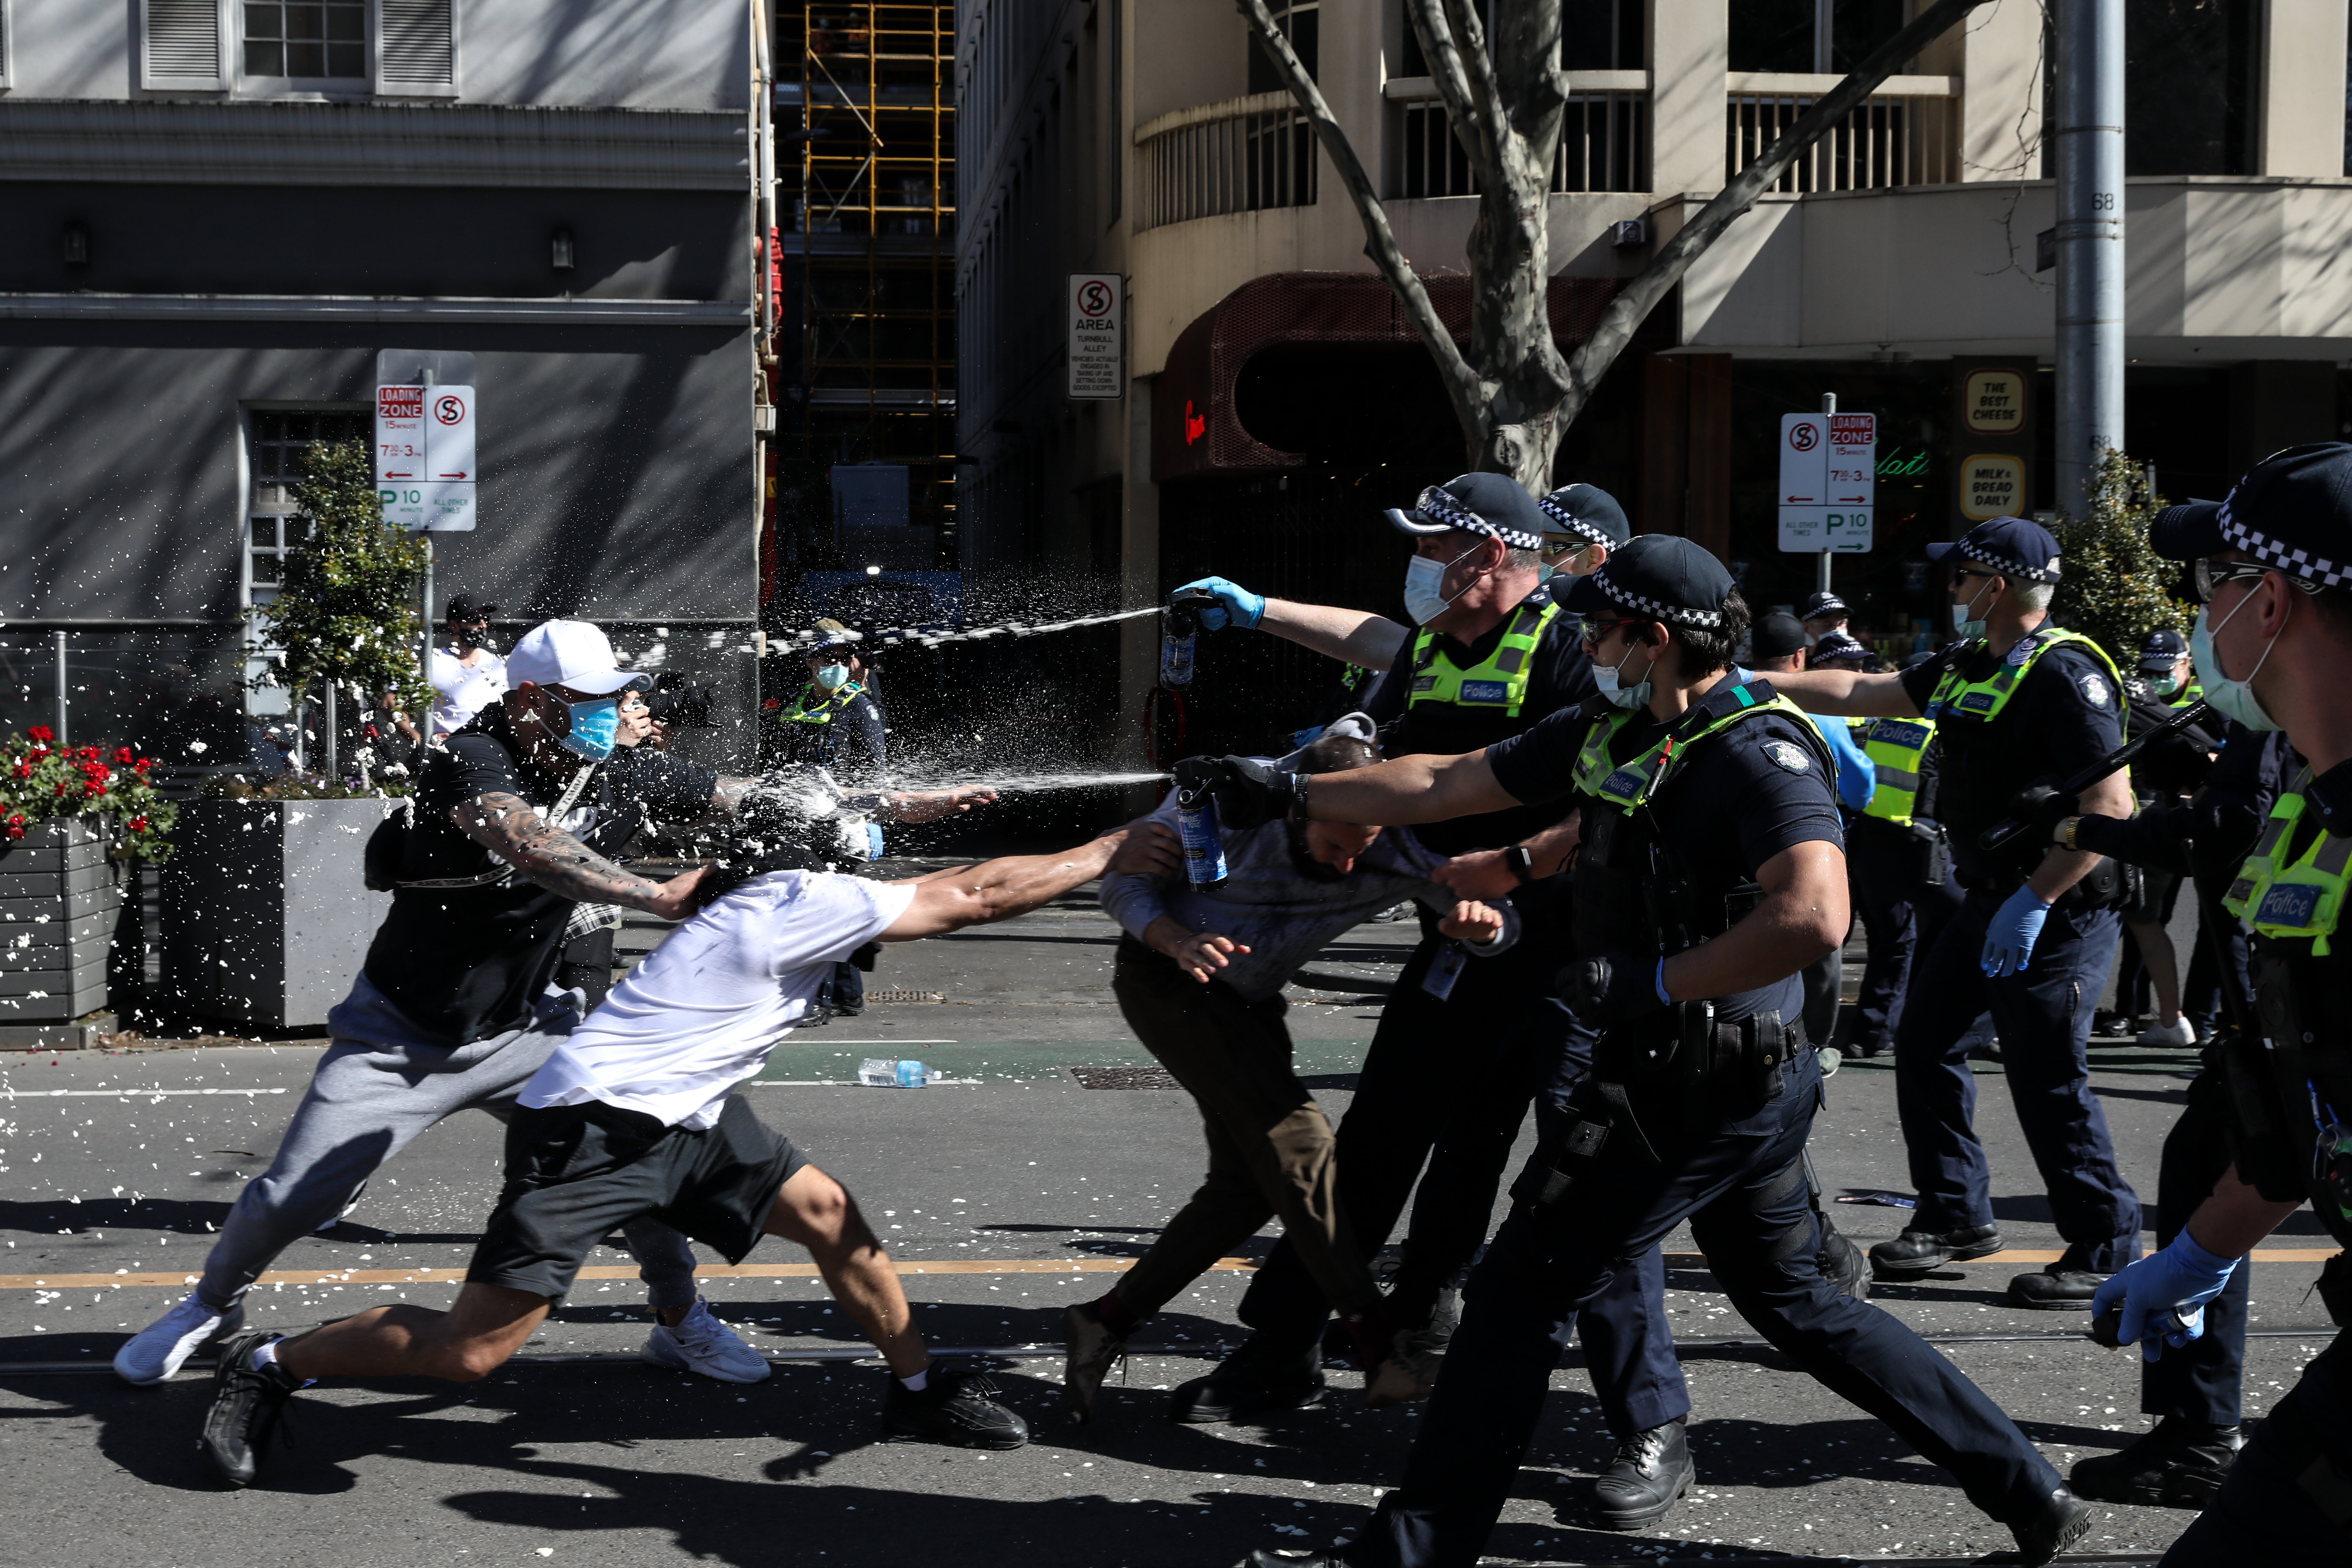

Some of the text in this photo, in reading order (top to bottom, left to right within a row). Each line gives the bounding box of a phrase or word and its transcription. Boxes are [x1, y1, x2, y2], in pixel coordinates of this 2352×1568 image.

[2091, 192, 2114, 210] 68
[1075, 319, 1114, 330] AREA
[1984, 382, 2007, 394] THE
[380, 389, 421, 402] LOADING
[1980, 396, 2011, 407] BEST
[380, 405, 422, 417] ZONE
[1973, 409, 2017, 420] CHEESE
[1832, 417, 1872, 429] LOADING
[1831, 432, 1873, 443] ZONE
[2088, 435, 2113, 451] 68
[1975, 468, 2004, 479] MILK
[1973, 482, 2013, 492] BREAD
[379, 490, 421, 511] P 10
[448, 499, 468, 507] OTHER
[1975, 495, 2011, 506] DAILY
[1826, 514, 1867, 535] P 10
[1463, 684, 1503, 698] Police
[1963, 694, 1989, 707] Police
[1872, 722, 1924, 744] Police
[1605, 774, 1633, 793] Police
[481, 864, 510, 882] JEANS
[2262, 892, 2309, 917] Police
